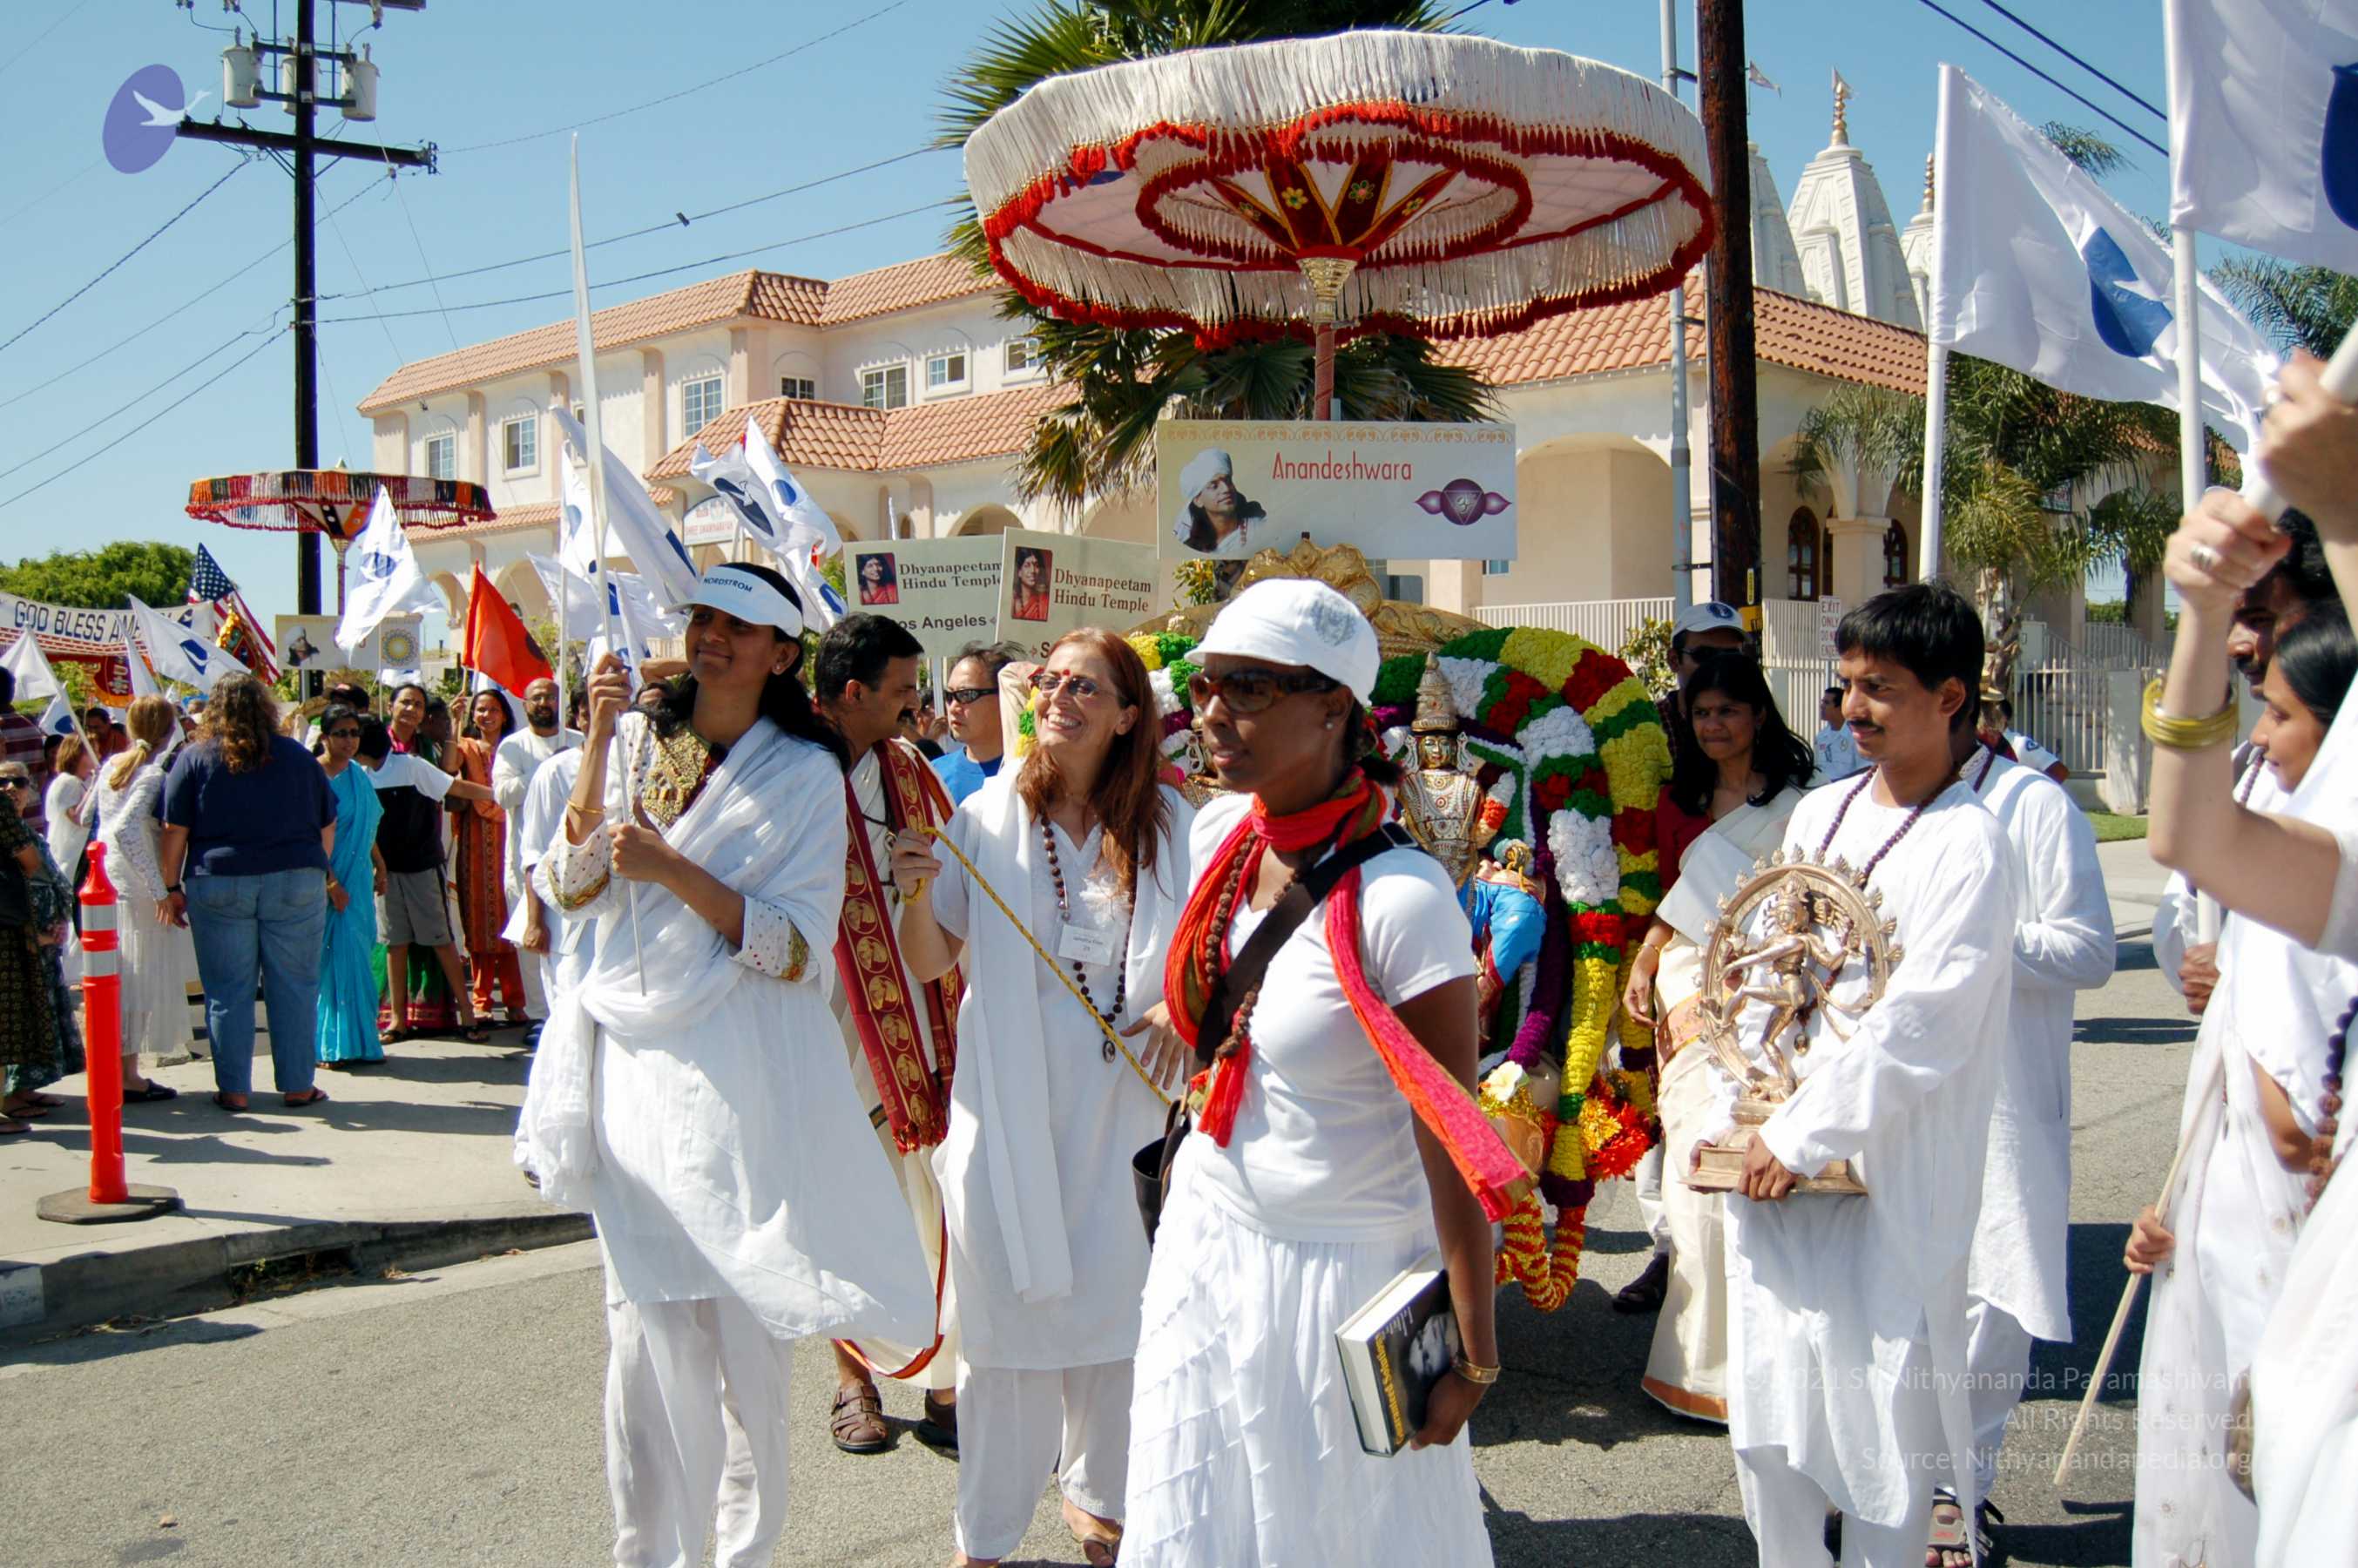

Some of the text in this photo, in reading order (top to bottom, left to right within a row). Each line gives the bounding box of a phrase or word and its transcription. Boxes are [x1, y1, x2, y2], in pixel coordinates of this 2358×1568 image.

[1272, 449, 1412, 481] Anandeshwara
[900, 561, 1002, 577] Dhyanapeetam
[704, 578, 753, 592] NORDSTROM
[902, 578, 947, 590] Hindu
[1055, 568, 1151, 592] Dhyanapeetam
[1054, 588, 1149, 613] Hindu Temple
[1821, 600, 1840, 613] EXIT
[15, 600, 49, 632] GOD
[54, 610, 106, 642] BLESS
[898, 614, 987, 631] os Angeles
[1821, 615, 1839, 627] ONLY
